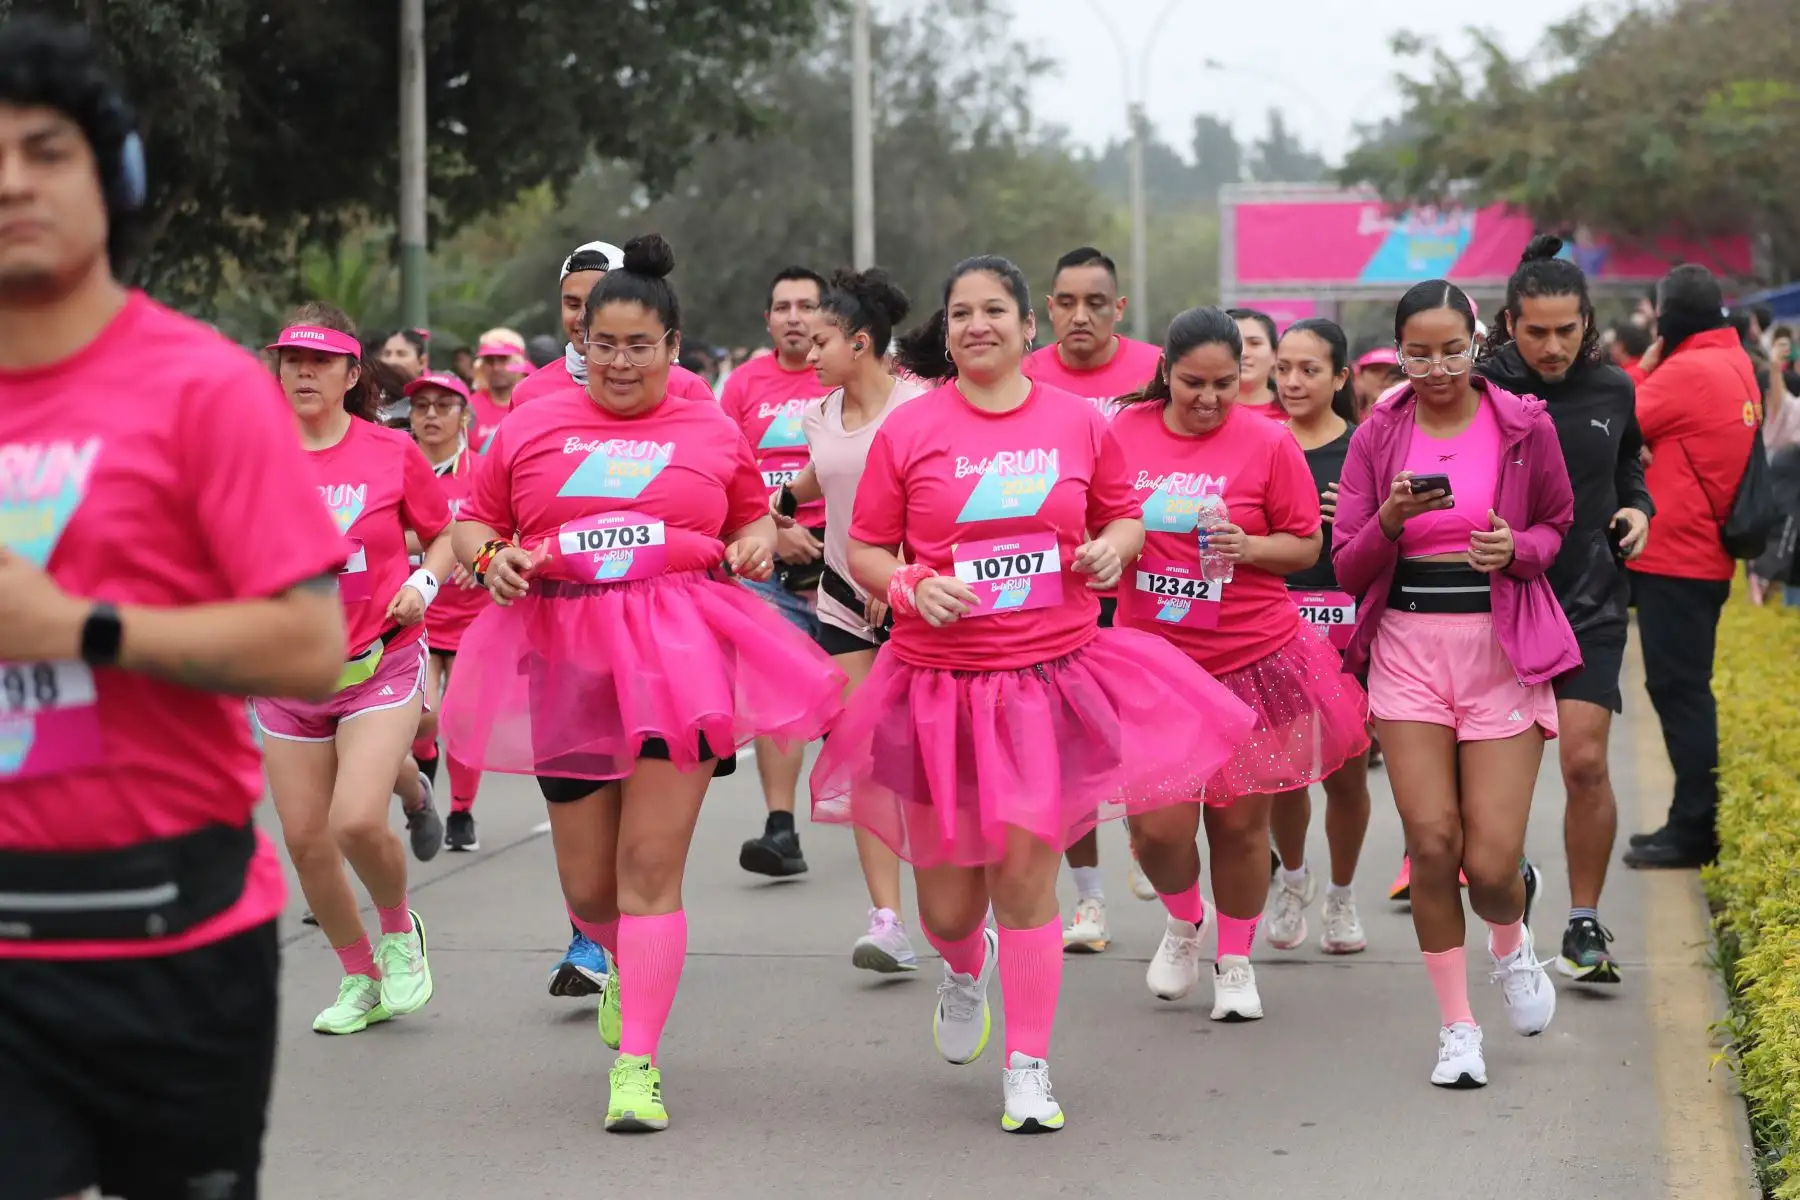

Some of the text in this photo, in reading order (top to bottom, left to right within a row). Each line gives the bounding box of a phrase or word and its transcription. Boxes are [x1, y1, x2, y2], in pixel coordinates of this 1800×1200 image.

[290, 330, 325, 341] aruma
[606, 439, 676, 461] RUN
[996, 448, 1060, 478] RUN
[768, 471, 800, 486] 123
[1001, 477, 1047, 496] 2024
[576, 525, 651, 551] 10703
[992, 543, 1020, 552] aruma
[973, 552, 1044, 580] 10707
[1165, 566, 1189, 574] aruma
[1006, 577, 1031, 591] RUN
[1148, 574, 1210, 599] 12342
